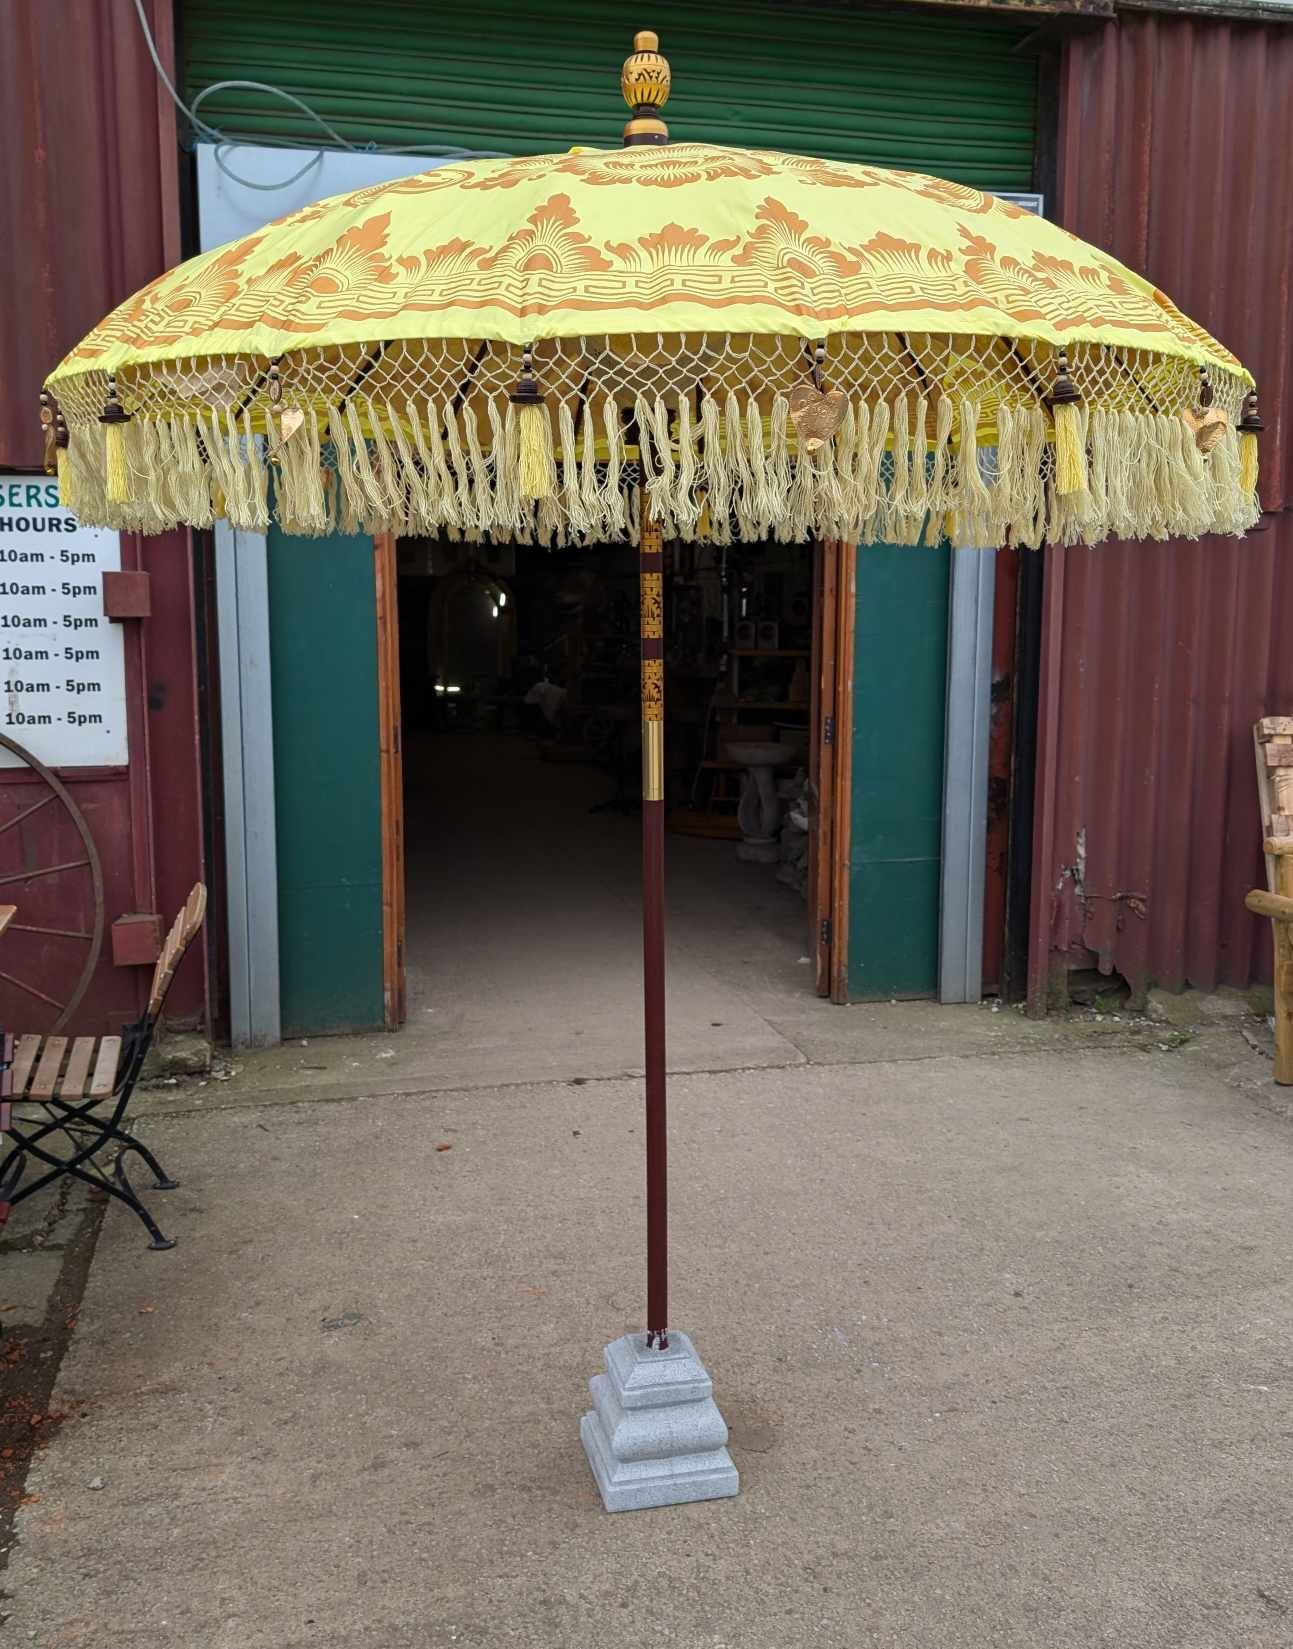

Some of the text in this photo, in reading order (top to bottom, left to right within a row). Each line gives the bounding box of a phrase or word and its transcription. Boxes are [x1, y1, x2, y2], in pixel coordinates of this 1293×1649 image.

[0, 516, 77, 532] HOURS
[0, 550, 44, 562] 10am
[60, 550, 95, 565] 5pm
[0, 583, 45, 595] 10am
[62, 583, 97, 598] 5pm
[1, 615, 47, 627] 10am
[63, 615, 98, 630] 5pm
[3, 648, 48, 660] 10am
[65, 647, 99, 662] 5pm
[4, 680, 50, 692] 10am
[66, 680, 101, 694] 5pm
[6, 712, 51, 725] 10am
[68, 712, 102, 726] 5pm
